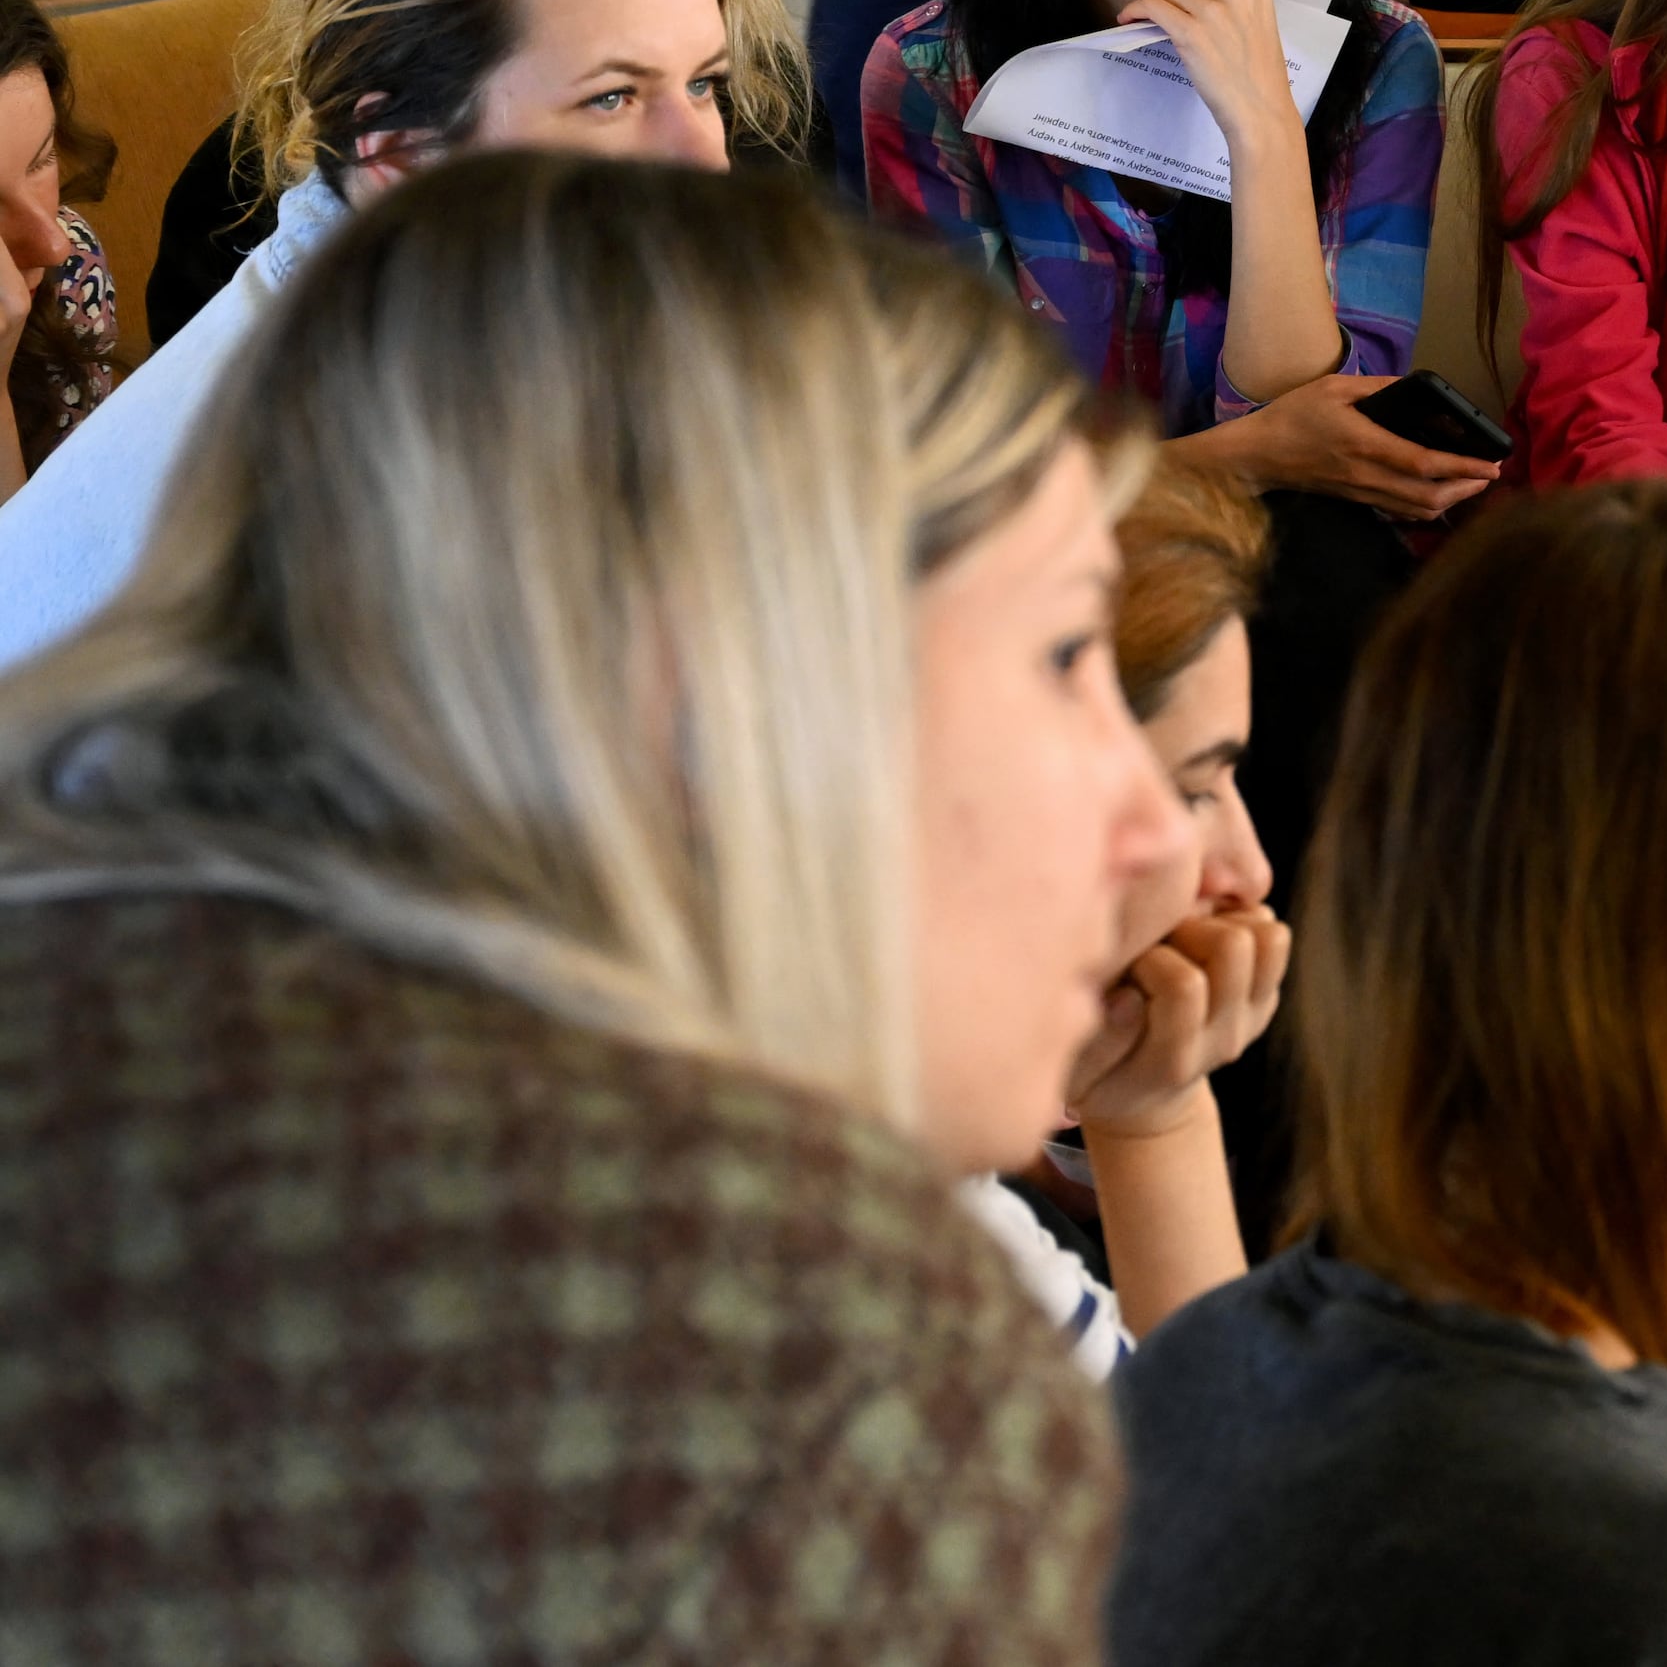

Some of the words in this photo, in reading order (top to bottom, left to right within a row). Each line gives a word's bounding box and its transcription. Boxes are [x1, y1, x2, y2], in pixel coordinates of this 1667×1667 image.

[1102, 52, 1114, 61] та
[1115, 56, 1148, 72] талони
[1140, 47, 1181, 67] (людей
[1150, 67, 1194, 88] осадкові
[1033, 113, 1070, 130] паркінг
[1027, 127, 1055, 143] чергу
[1072, 125, 1085, 135] на
[1057, 138, 1069, 148] та
[1087, 129, 1145, 156] заїзджають
[1070, 141, 1110, 161] висадку
[1146, 150, 1161, 160] які
[1113, 156, 1125, 168] чи
[1126, 162, 1168, 180] посадку
[1162, 157, 1227, 184] автомобілей
[1170, 176, 1183, 185] на
